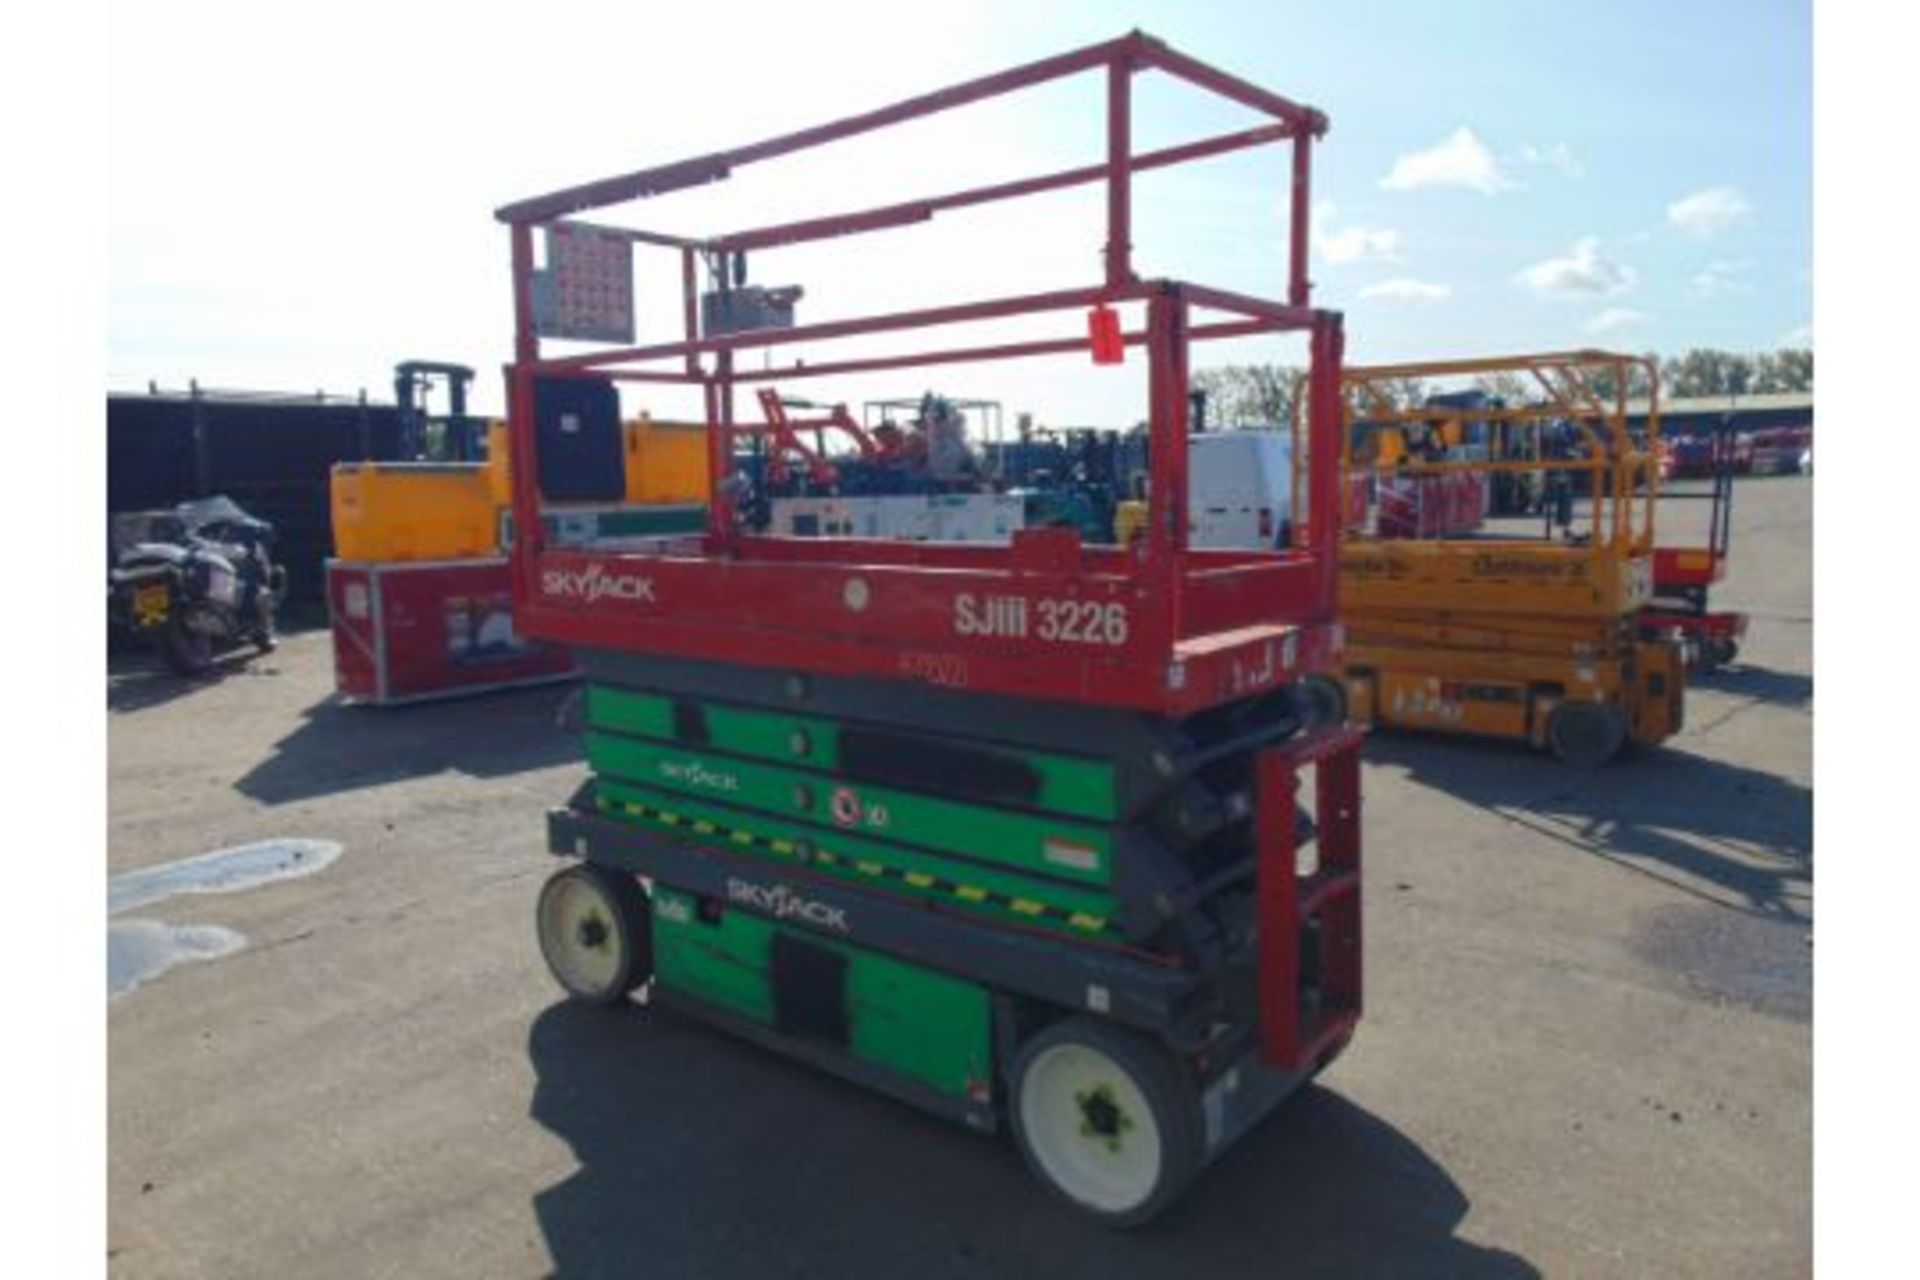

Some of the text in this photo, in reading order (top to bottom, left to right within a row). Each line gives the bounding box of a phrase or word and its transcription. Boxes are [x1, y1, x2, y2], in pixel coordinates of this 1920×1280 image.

[541, 564, 655, 603] SKYJACK
[1036, 599, 1128, 645] 3226
[726, 877, 852, 933] SKYJACK
